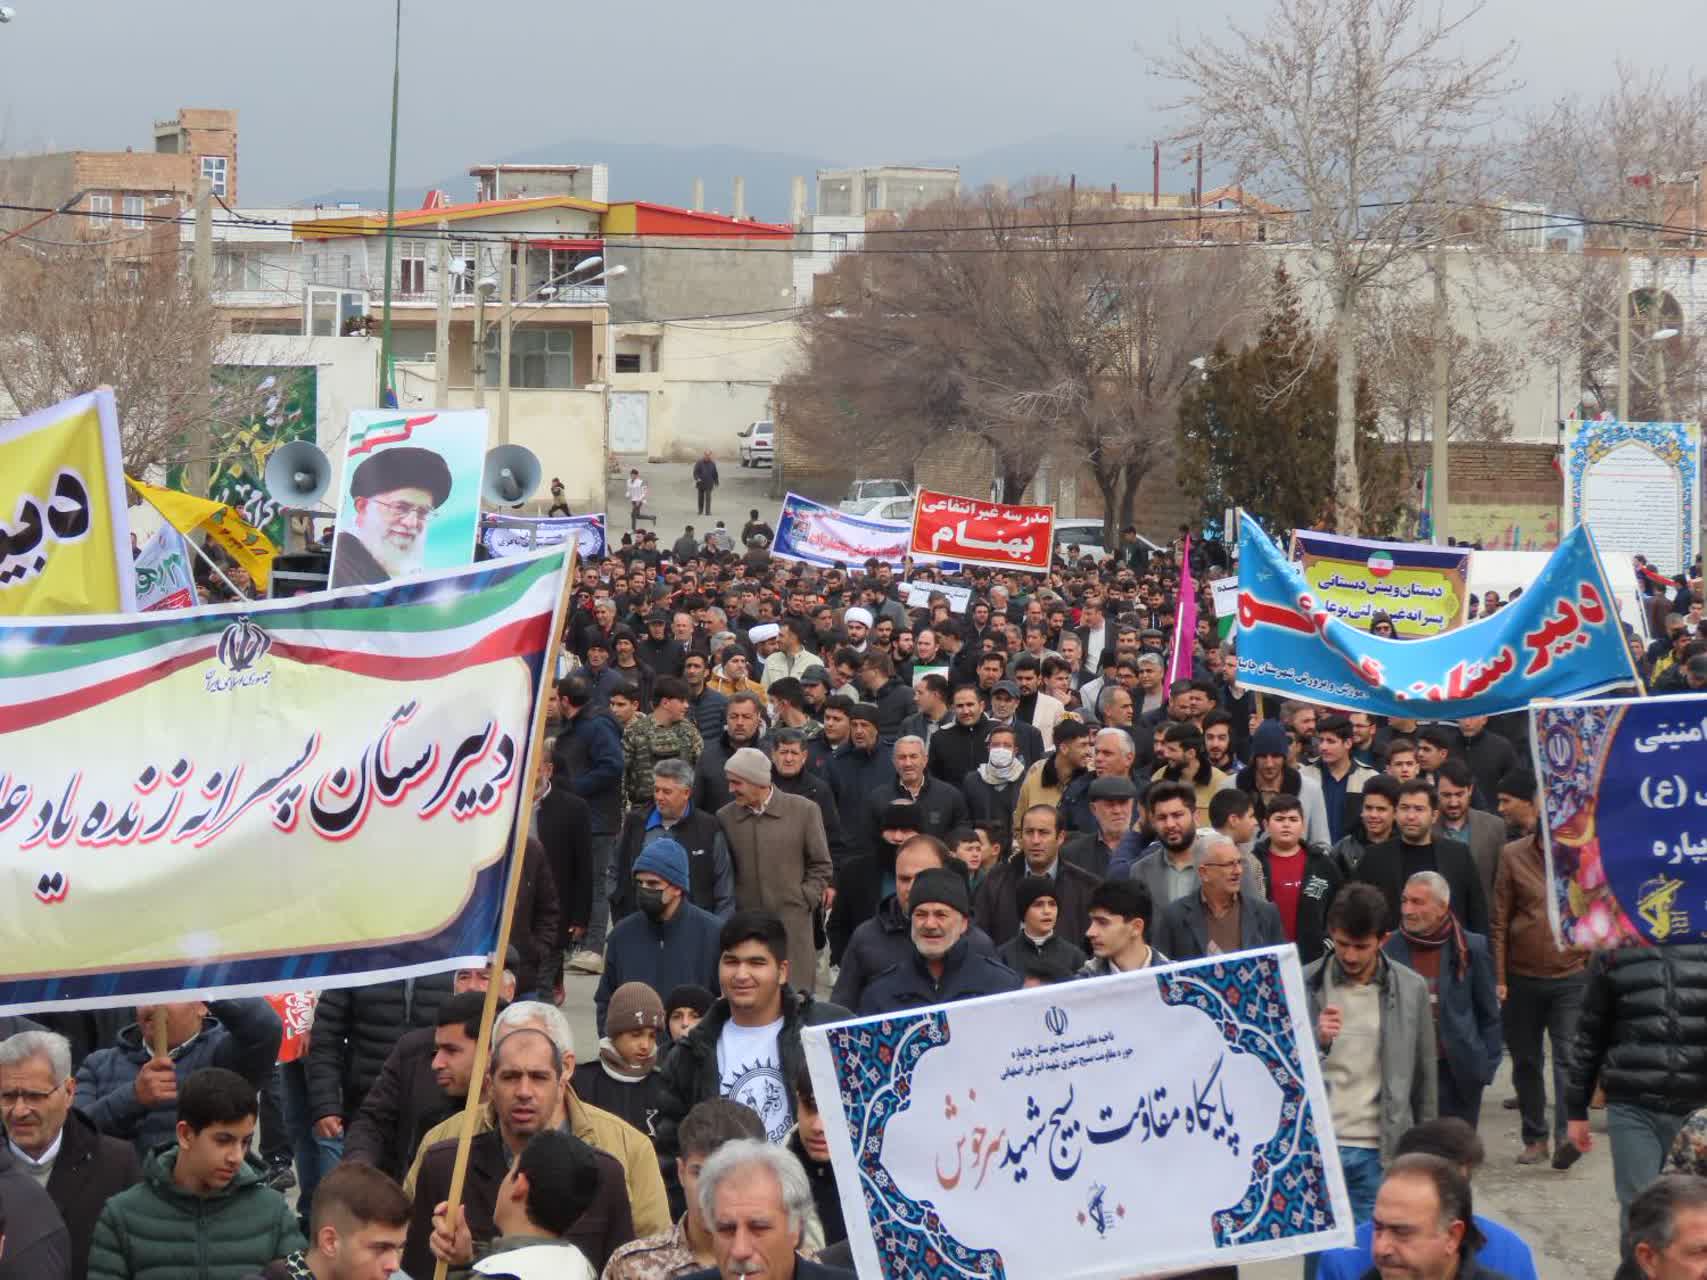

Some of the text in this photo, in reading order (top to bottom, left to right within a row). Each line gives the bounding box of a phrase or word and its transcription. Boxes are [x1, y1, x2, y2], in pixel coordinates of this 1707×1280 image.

[0, 473, 89, 584] دبی
[921, 498, 1049, 527] مدرسه غیر انتفاعی
[931, 519, 1035, 561] بهنام
[1318, 575, 1367, 590] دبستانی
[1400, 583, 1443, 598] دبستان
[174, 731, 318, 843] پسرانه
[310, 699, 516, 838] دبیرستان
[998, 1095, 1047, 1184] شهید
[1048, 1082, 1083, 1182] بسیج
[1085, 1085, 1181, 1146] مقاومت
[1184, 1050, 1241, 1158] پایگاه
